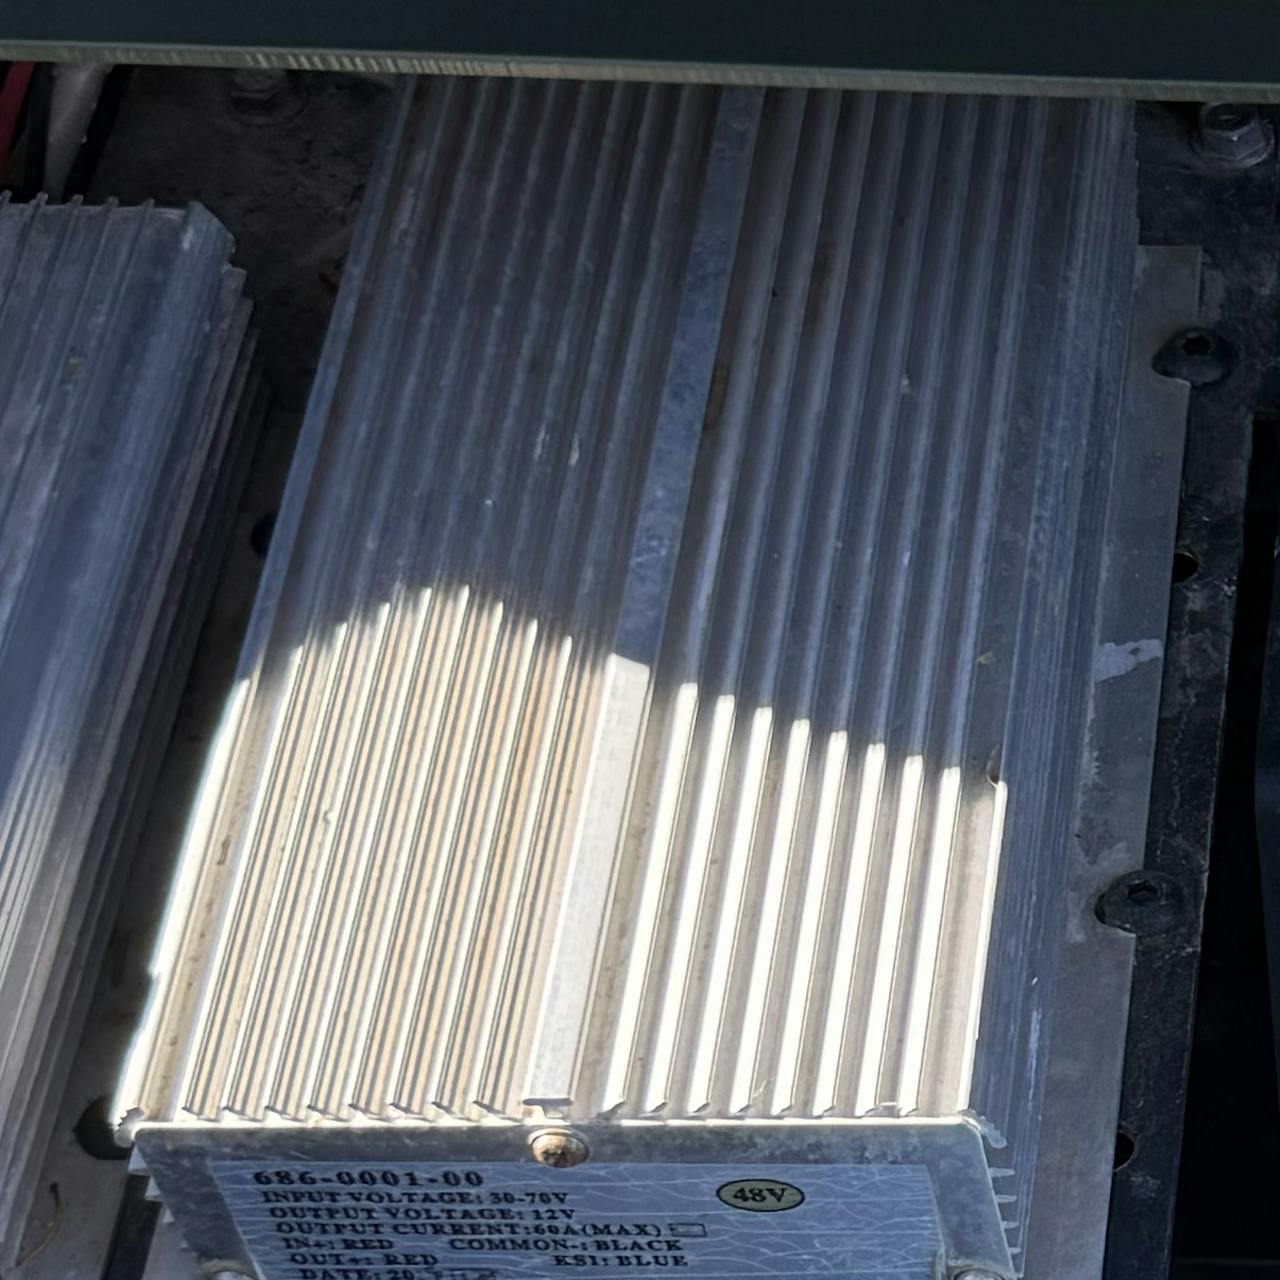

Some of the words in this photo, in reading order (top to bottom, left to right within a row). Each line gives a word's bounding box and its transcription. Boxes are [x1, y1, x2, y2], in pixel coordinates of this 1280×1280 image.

[253, 1170, 485, 1188] 686-0001-00
[262, 1191, 342, 1204] INPUT
[350, 1192, 482, 1204] VOLTAGE:
[733, 1187, 789, 1202] 48V
[269, 1207, 378, 1220] OUTPUT
[386, 1208, 524, 1220] VOLTAGE:
[533, 1208, 576, 1220] 12V
[275, 1222, 385, 1235] OUTPUT
[341, 1239, 395, 1250] RED
[594, 1239, 684, 1251] BLACK
[383, 1254, 439, 1266] RED
[614, 1255, 689, 1267] BLUE
[301, 1268, 382, 1280] DATE:
